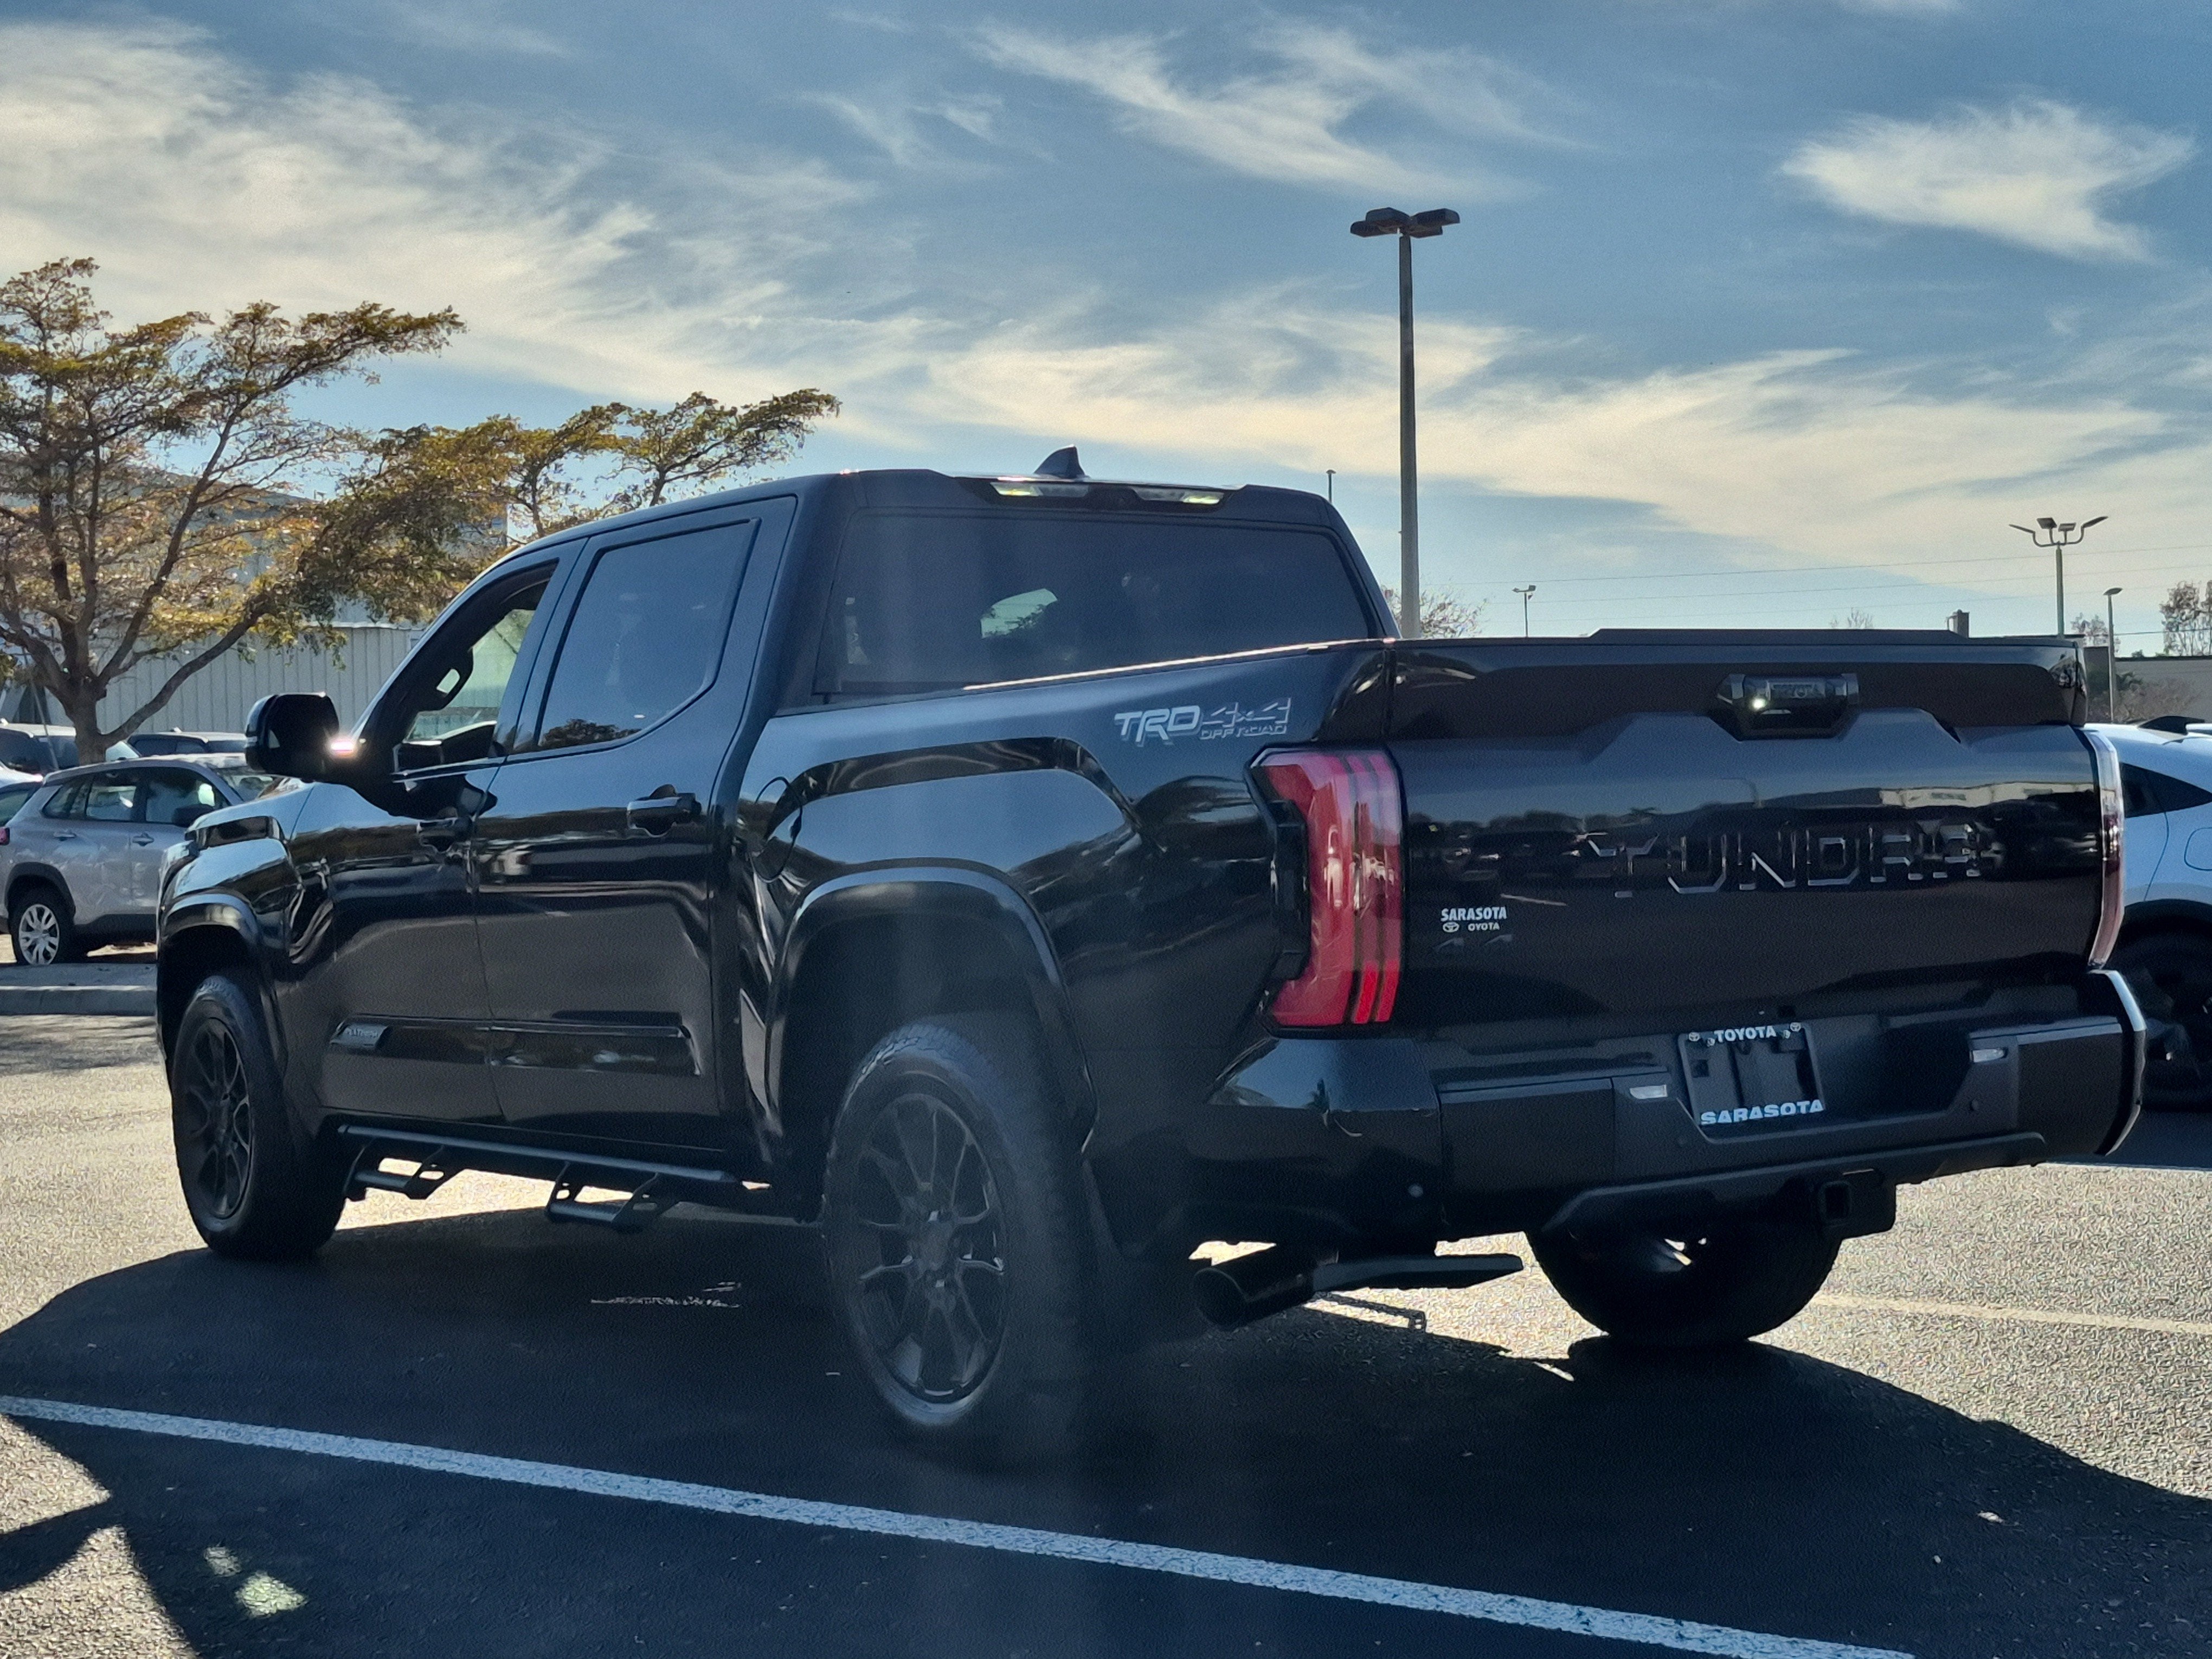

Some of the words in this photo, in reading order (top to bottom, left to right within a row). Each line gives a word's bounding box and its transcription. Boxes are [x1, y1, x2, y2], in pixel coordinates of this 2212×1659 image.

[1114, 705, 1204, 747] TRD
[1200, 698, 1291, 728] 4x4
[1441, 906, 1507, 922] SARASOTA
[1714, 1026, 1777, 1043] TOYOTA
[1701, 1099, 1824, 1125] SARASOTA
